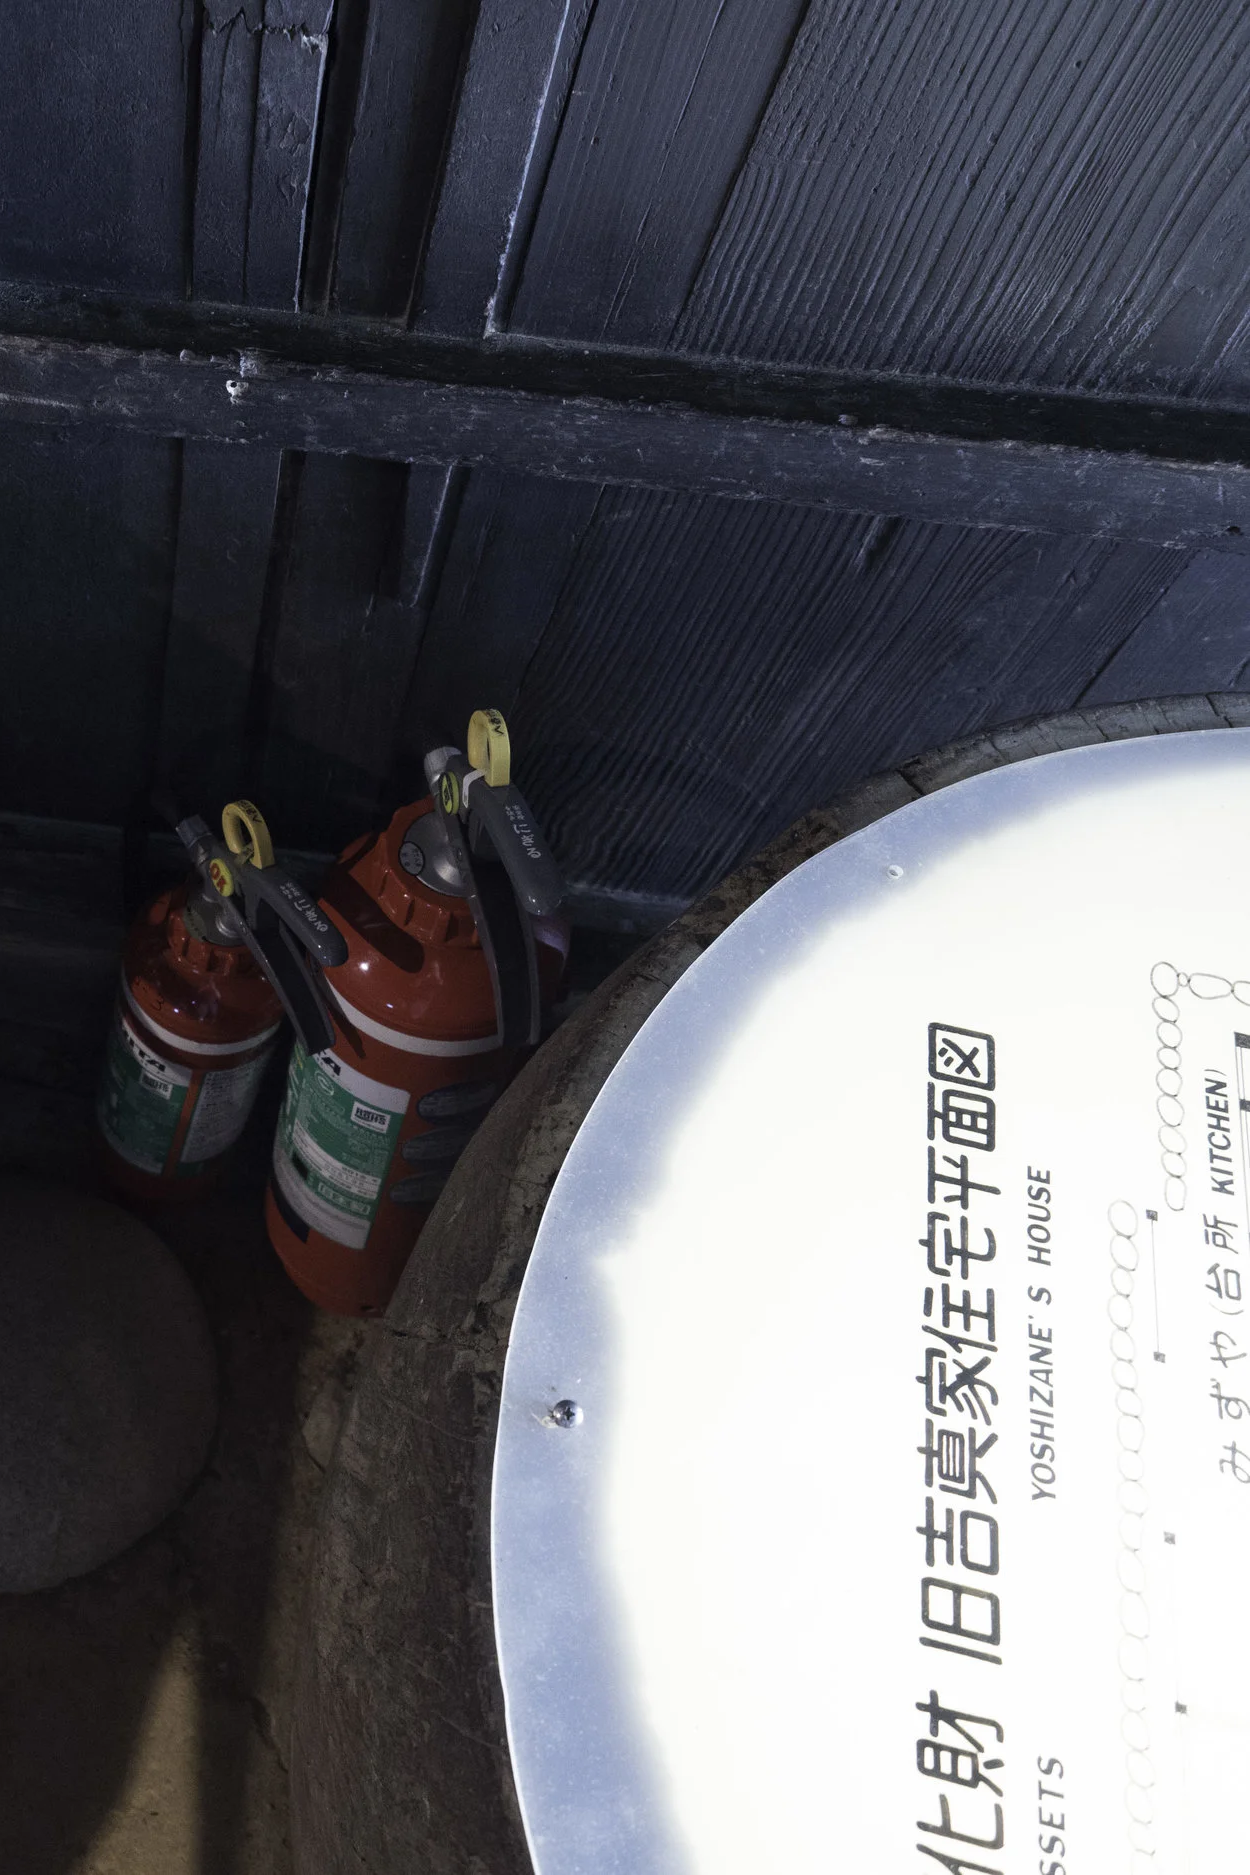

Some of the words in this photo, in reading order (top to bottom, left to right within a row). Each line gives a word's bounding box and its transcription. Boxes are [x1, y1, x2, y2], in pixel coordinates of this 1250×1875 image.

[209, 862, 227, 894] OK
[1027, 1166, 1052, 1266] HOUSE
[915, 1022, 1002, 1665] 旧吉真家住宅平面図
